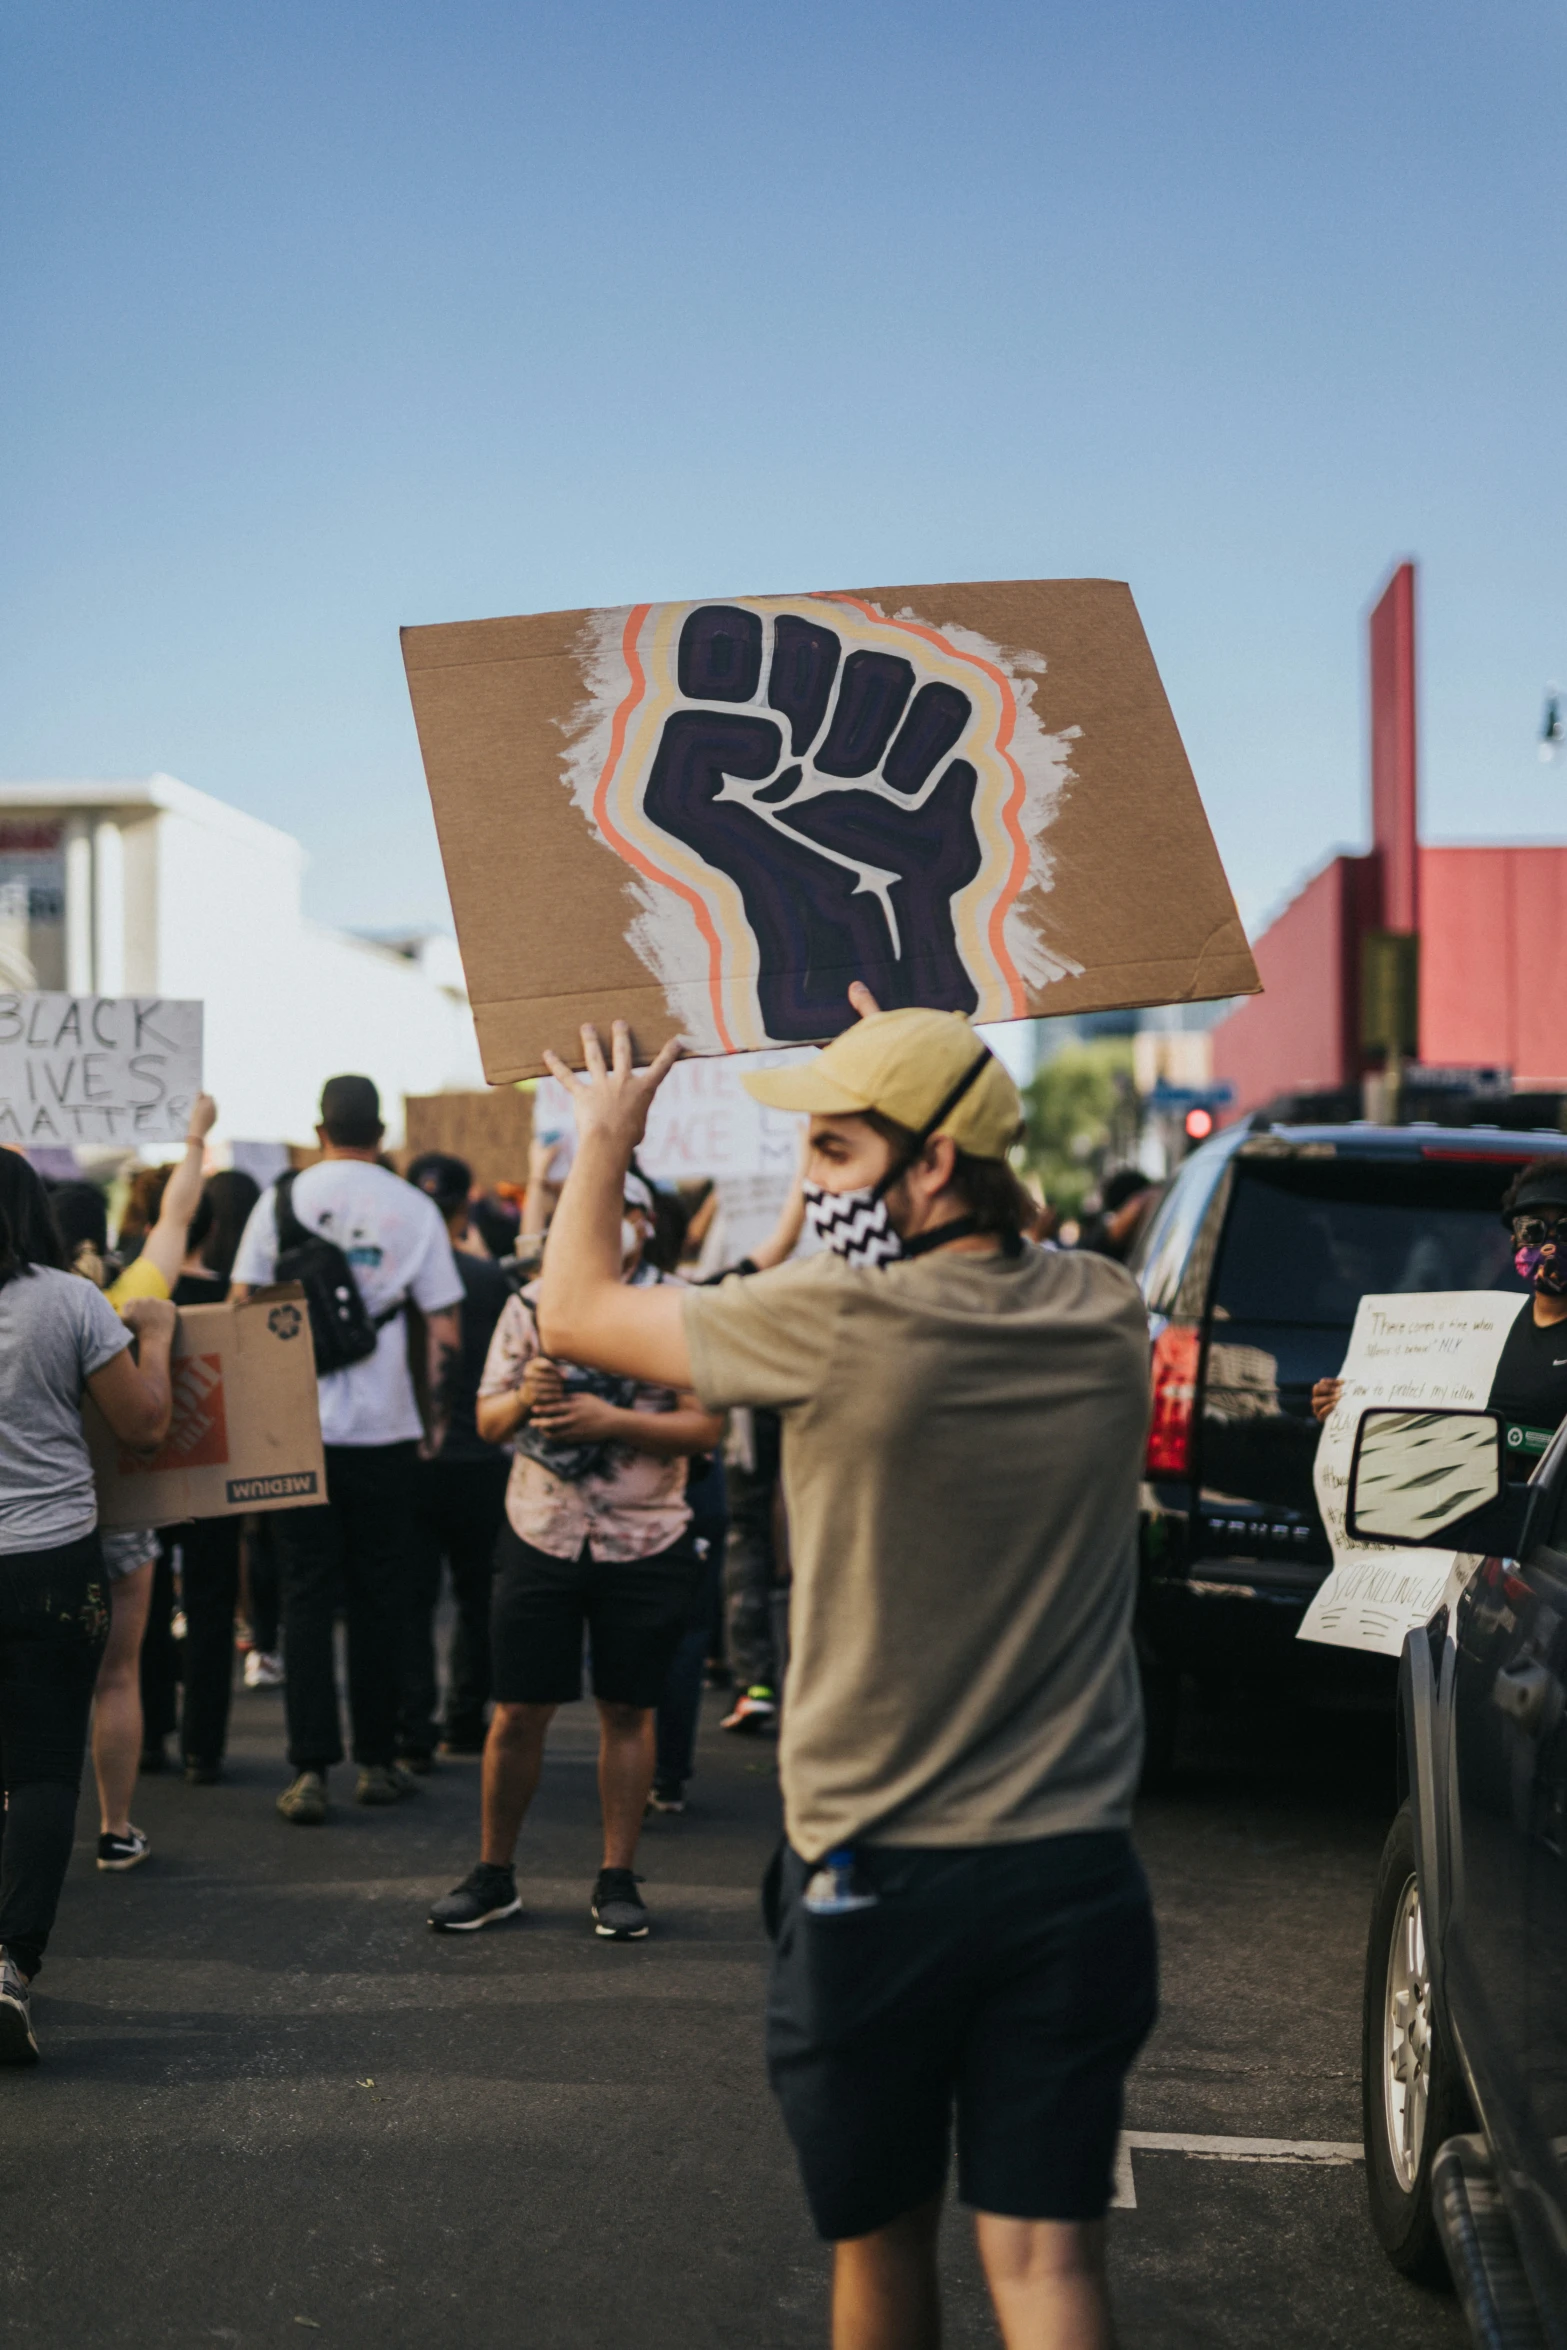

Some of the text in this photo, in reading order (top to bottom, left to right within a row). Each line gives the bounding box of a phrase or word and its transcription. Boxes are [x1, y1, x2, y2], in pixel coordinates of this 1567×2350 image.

[0, 994, 182, 1052] BLACK
[0, 1053, 168, 1104] IVES
[1387, 1379, 1427, 1402] protect
[231, 1475, 312, 1500] MEDIUM
